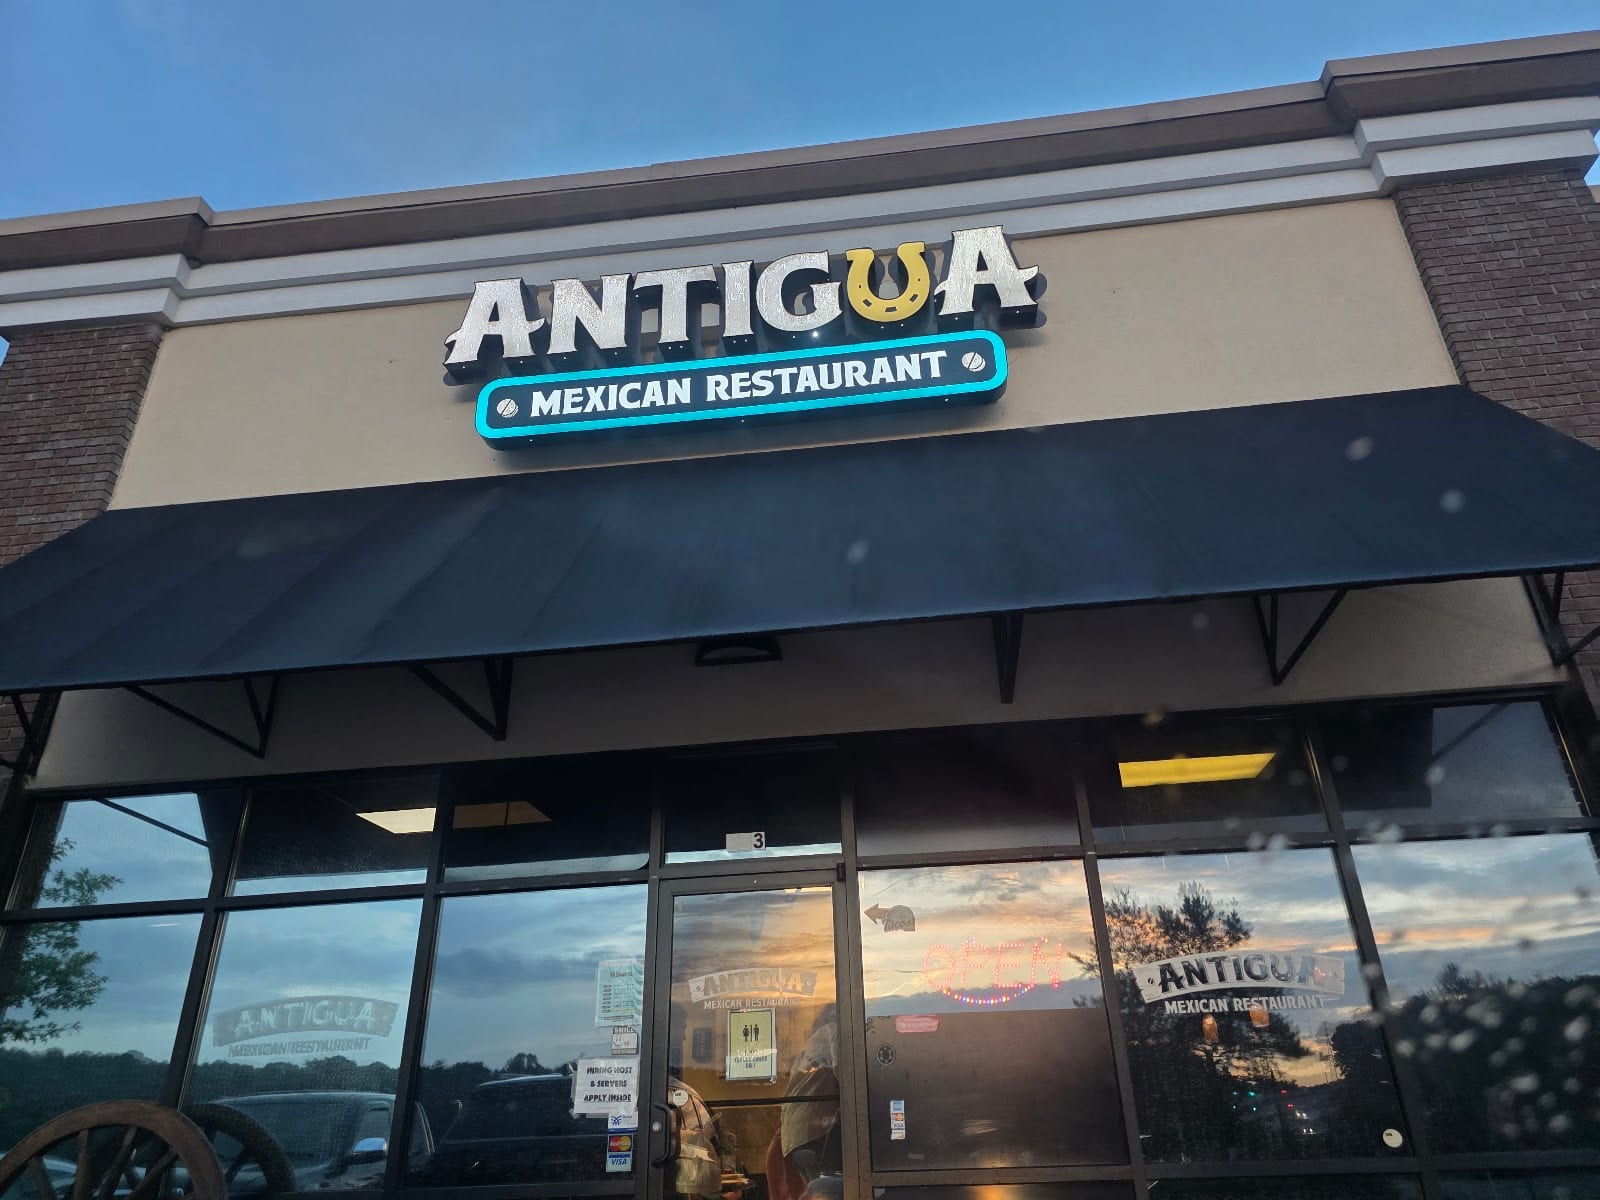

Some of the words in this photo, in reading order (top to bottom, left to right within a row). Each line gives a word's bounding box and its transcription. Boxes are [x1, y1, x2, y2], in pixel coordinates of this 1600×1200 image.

[443, 225, 1039, 365] ANTIGUA
[531, 377, 692, 418] MEXICAN
[706, 350, 947, 402] RESTAURANT
[753, 833, 764, 849] 3
[923, 942, 1063, 988] OPEN
[1159, 954, 1322, 993] ANTIGUA
[234, 1000, 376, 1036] ANTIGUA
[704, 999, 742, 1010] MEXICAN
[1165, 999, 1229, 1015] MEXICAN
[1233, 994, 1327, 1011] RESTAURANT
[584, 1094, 607, 1102] APPLY
